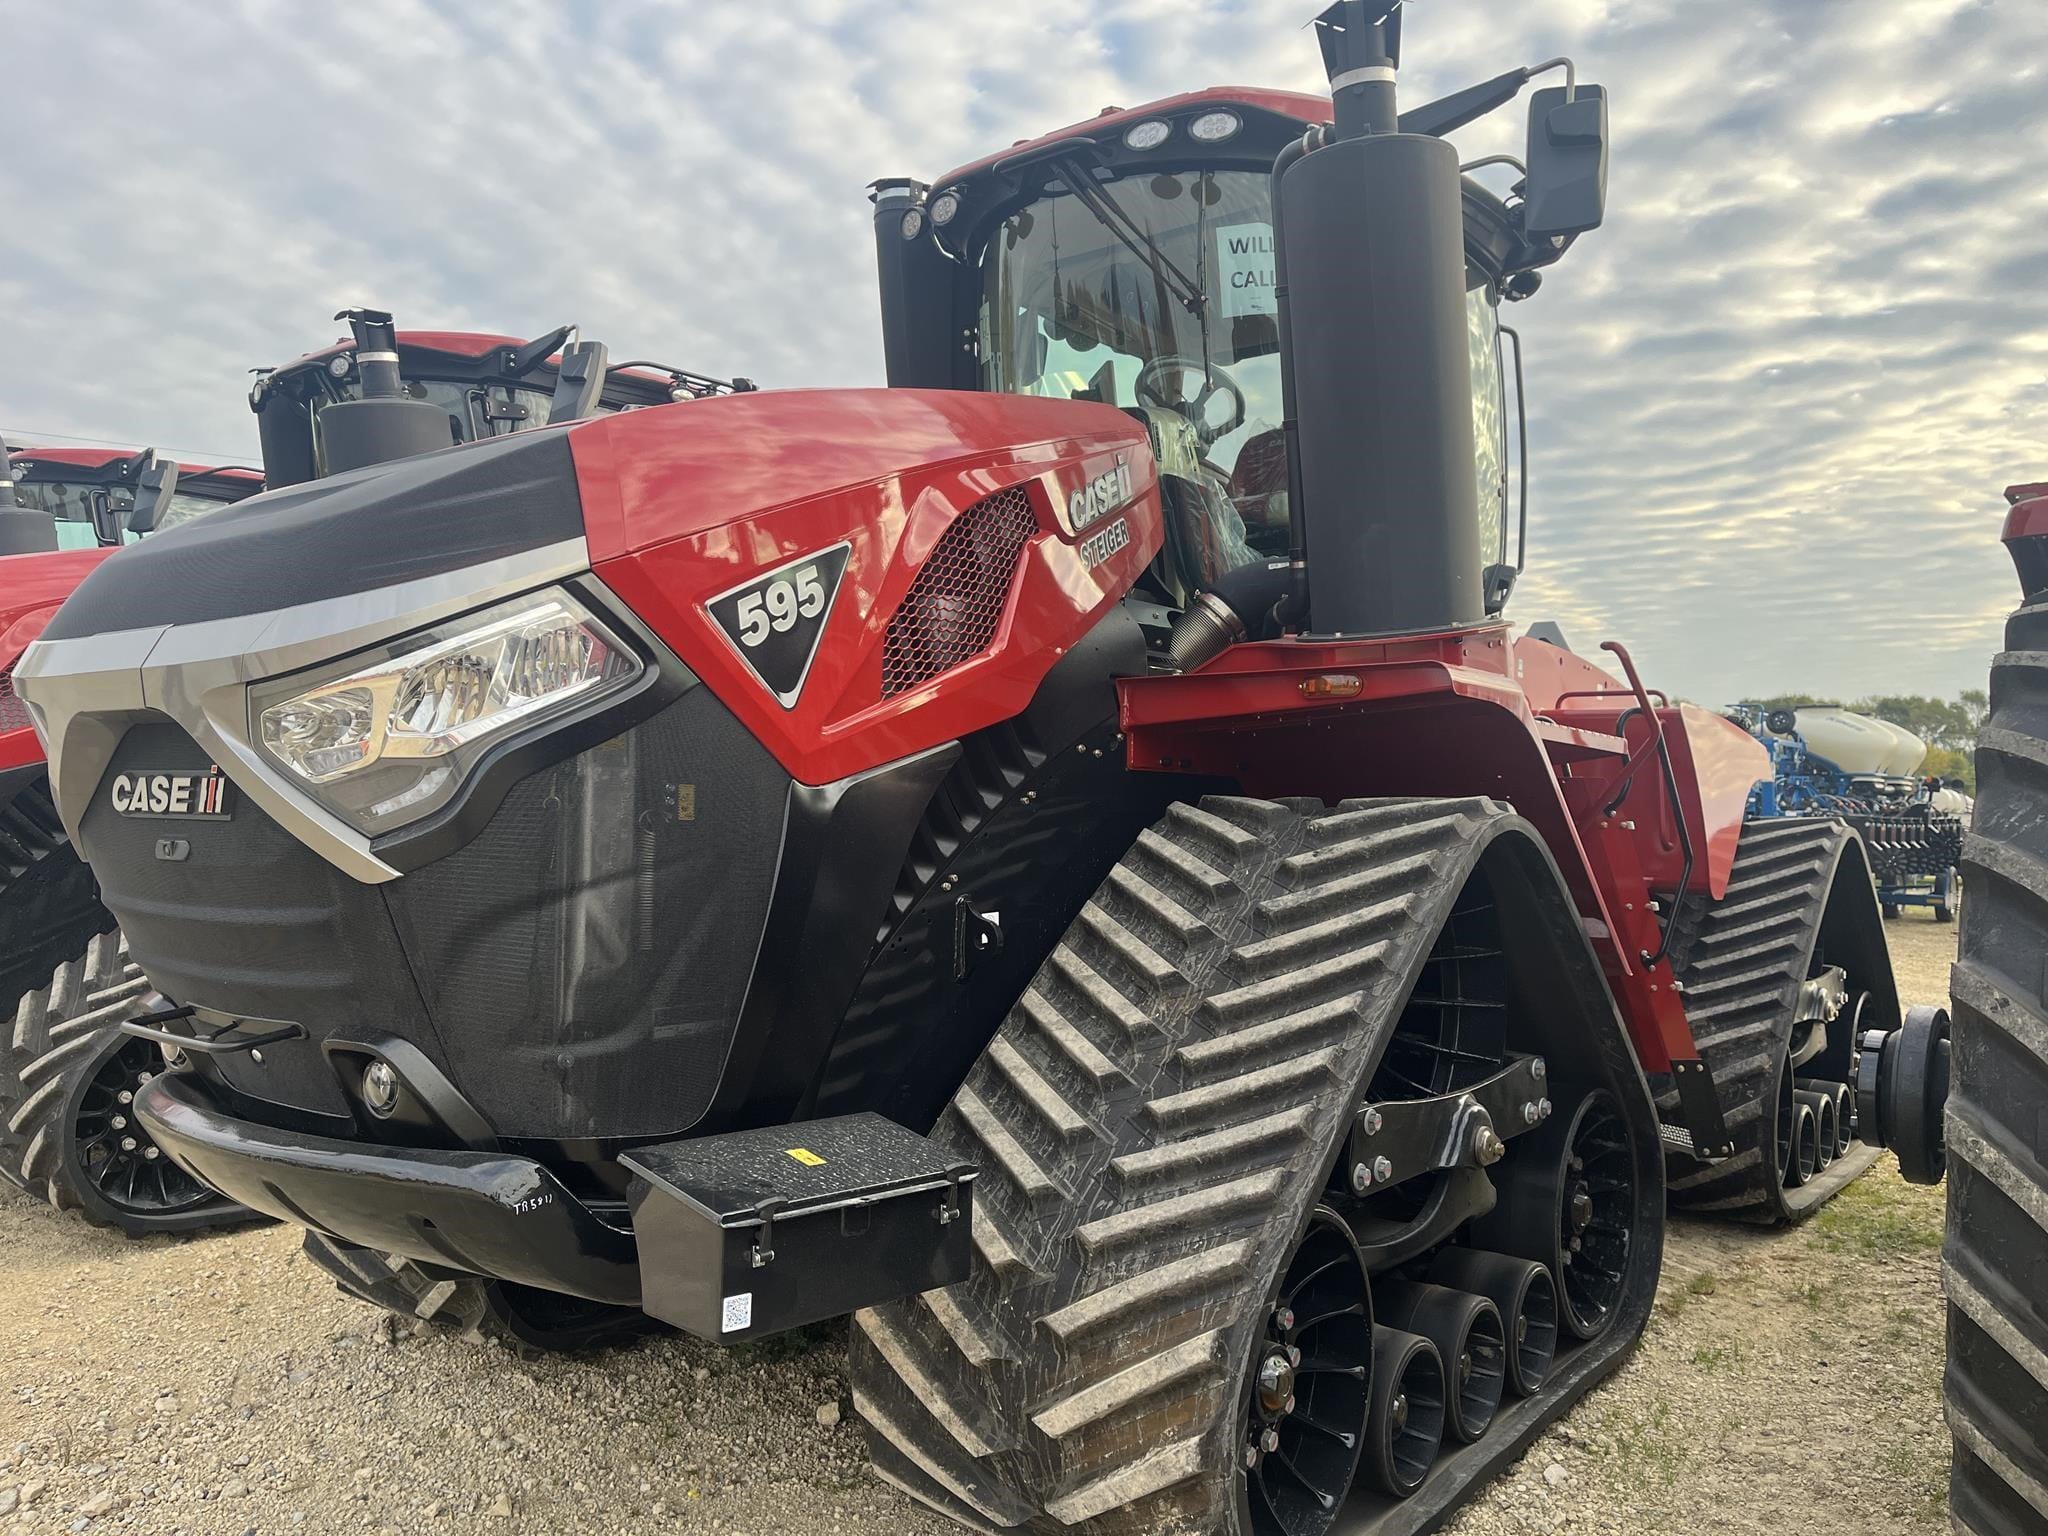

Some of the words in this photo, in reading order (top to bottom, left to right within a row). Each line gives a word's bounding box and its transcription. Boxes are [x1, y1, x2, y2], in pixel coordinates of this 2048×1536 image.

[1228, 236, 1275, 254] WILL
[1230, 270, 1276, 288] CALL
[1070, 472, 1119, 531] CASE
[1081, 518, 1129, 572] STEIGER
[737, 565, 825, 646] 595
[112, 774, 191, 812] CASE
